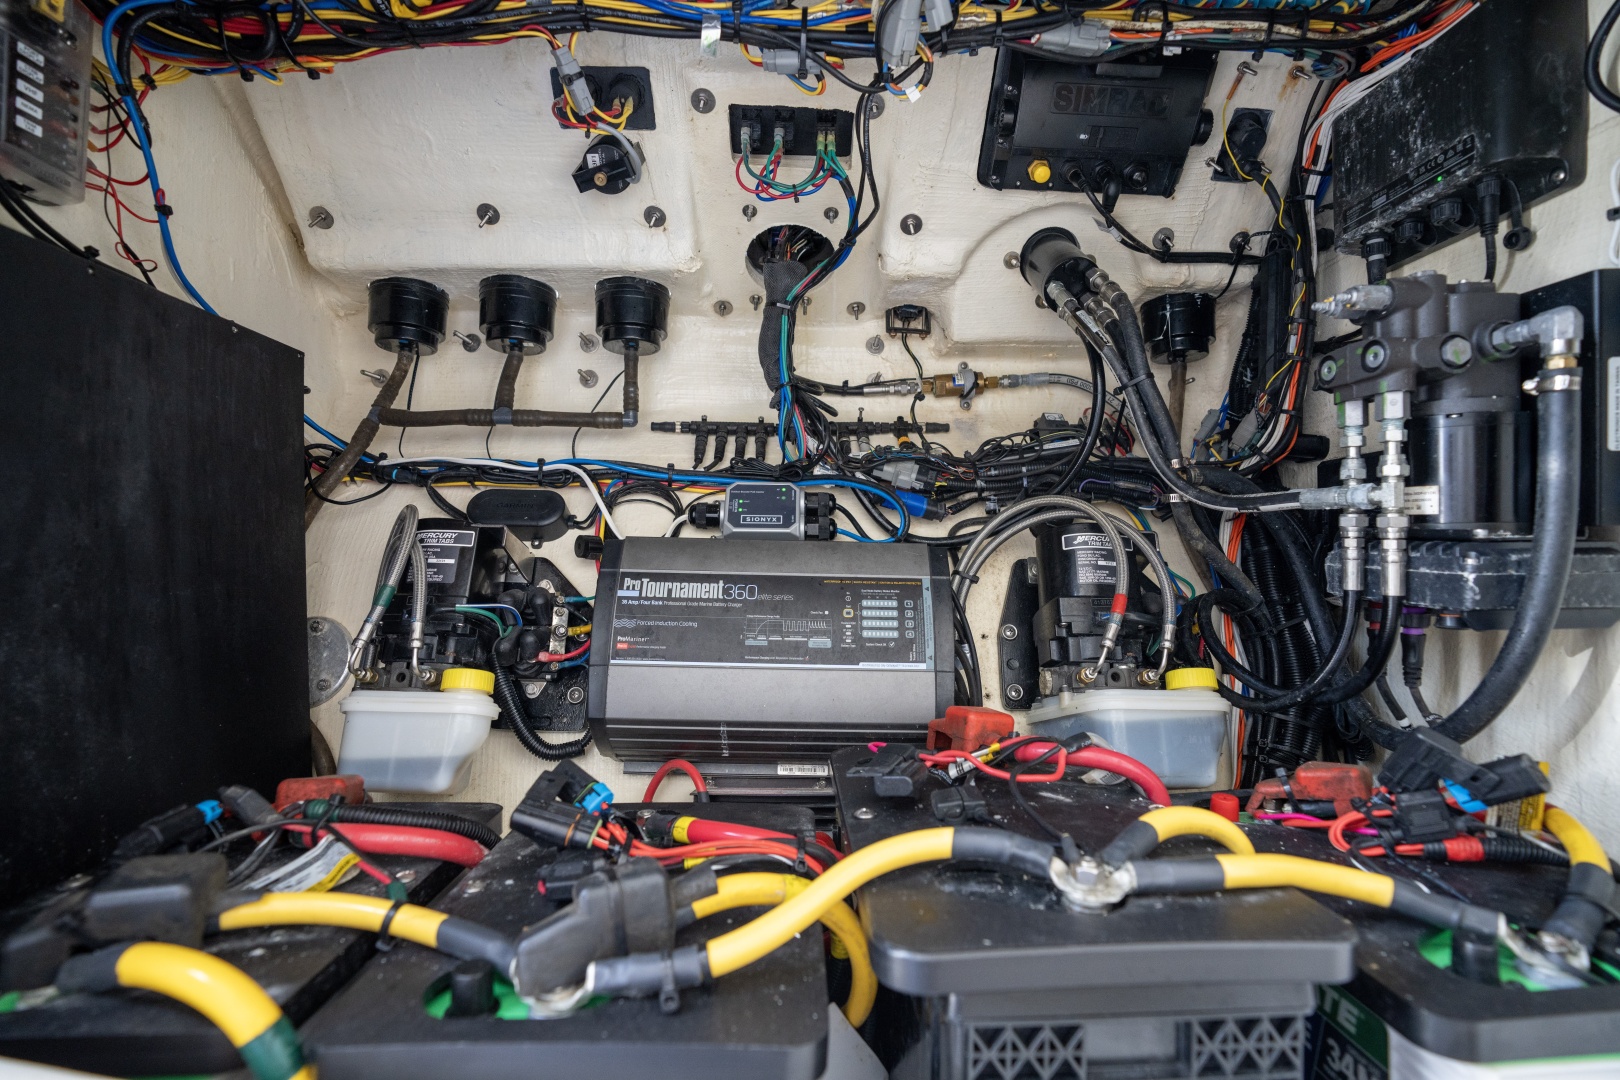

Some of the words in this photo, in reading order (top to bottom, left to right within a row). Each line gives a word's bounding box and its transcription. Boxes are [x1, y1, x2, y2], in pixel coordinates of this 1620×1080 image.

[416, 532, 458, 540] MERCURY
[758, 593, 772, 601] elite
[773, 593, 794, 601] series
